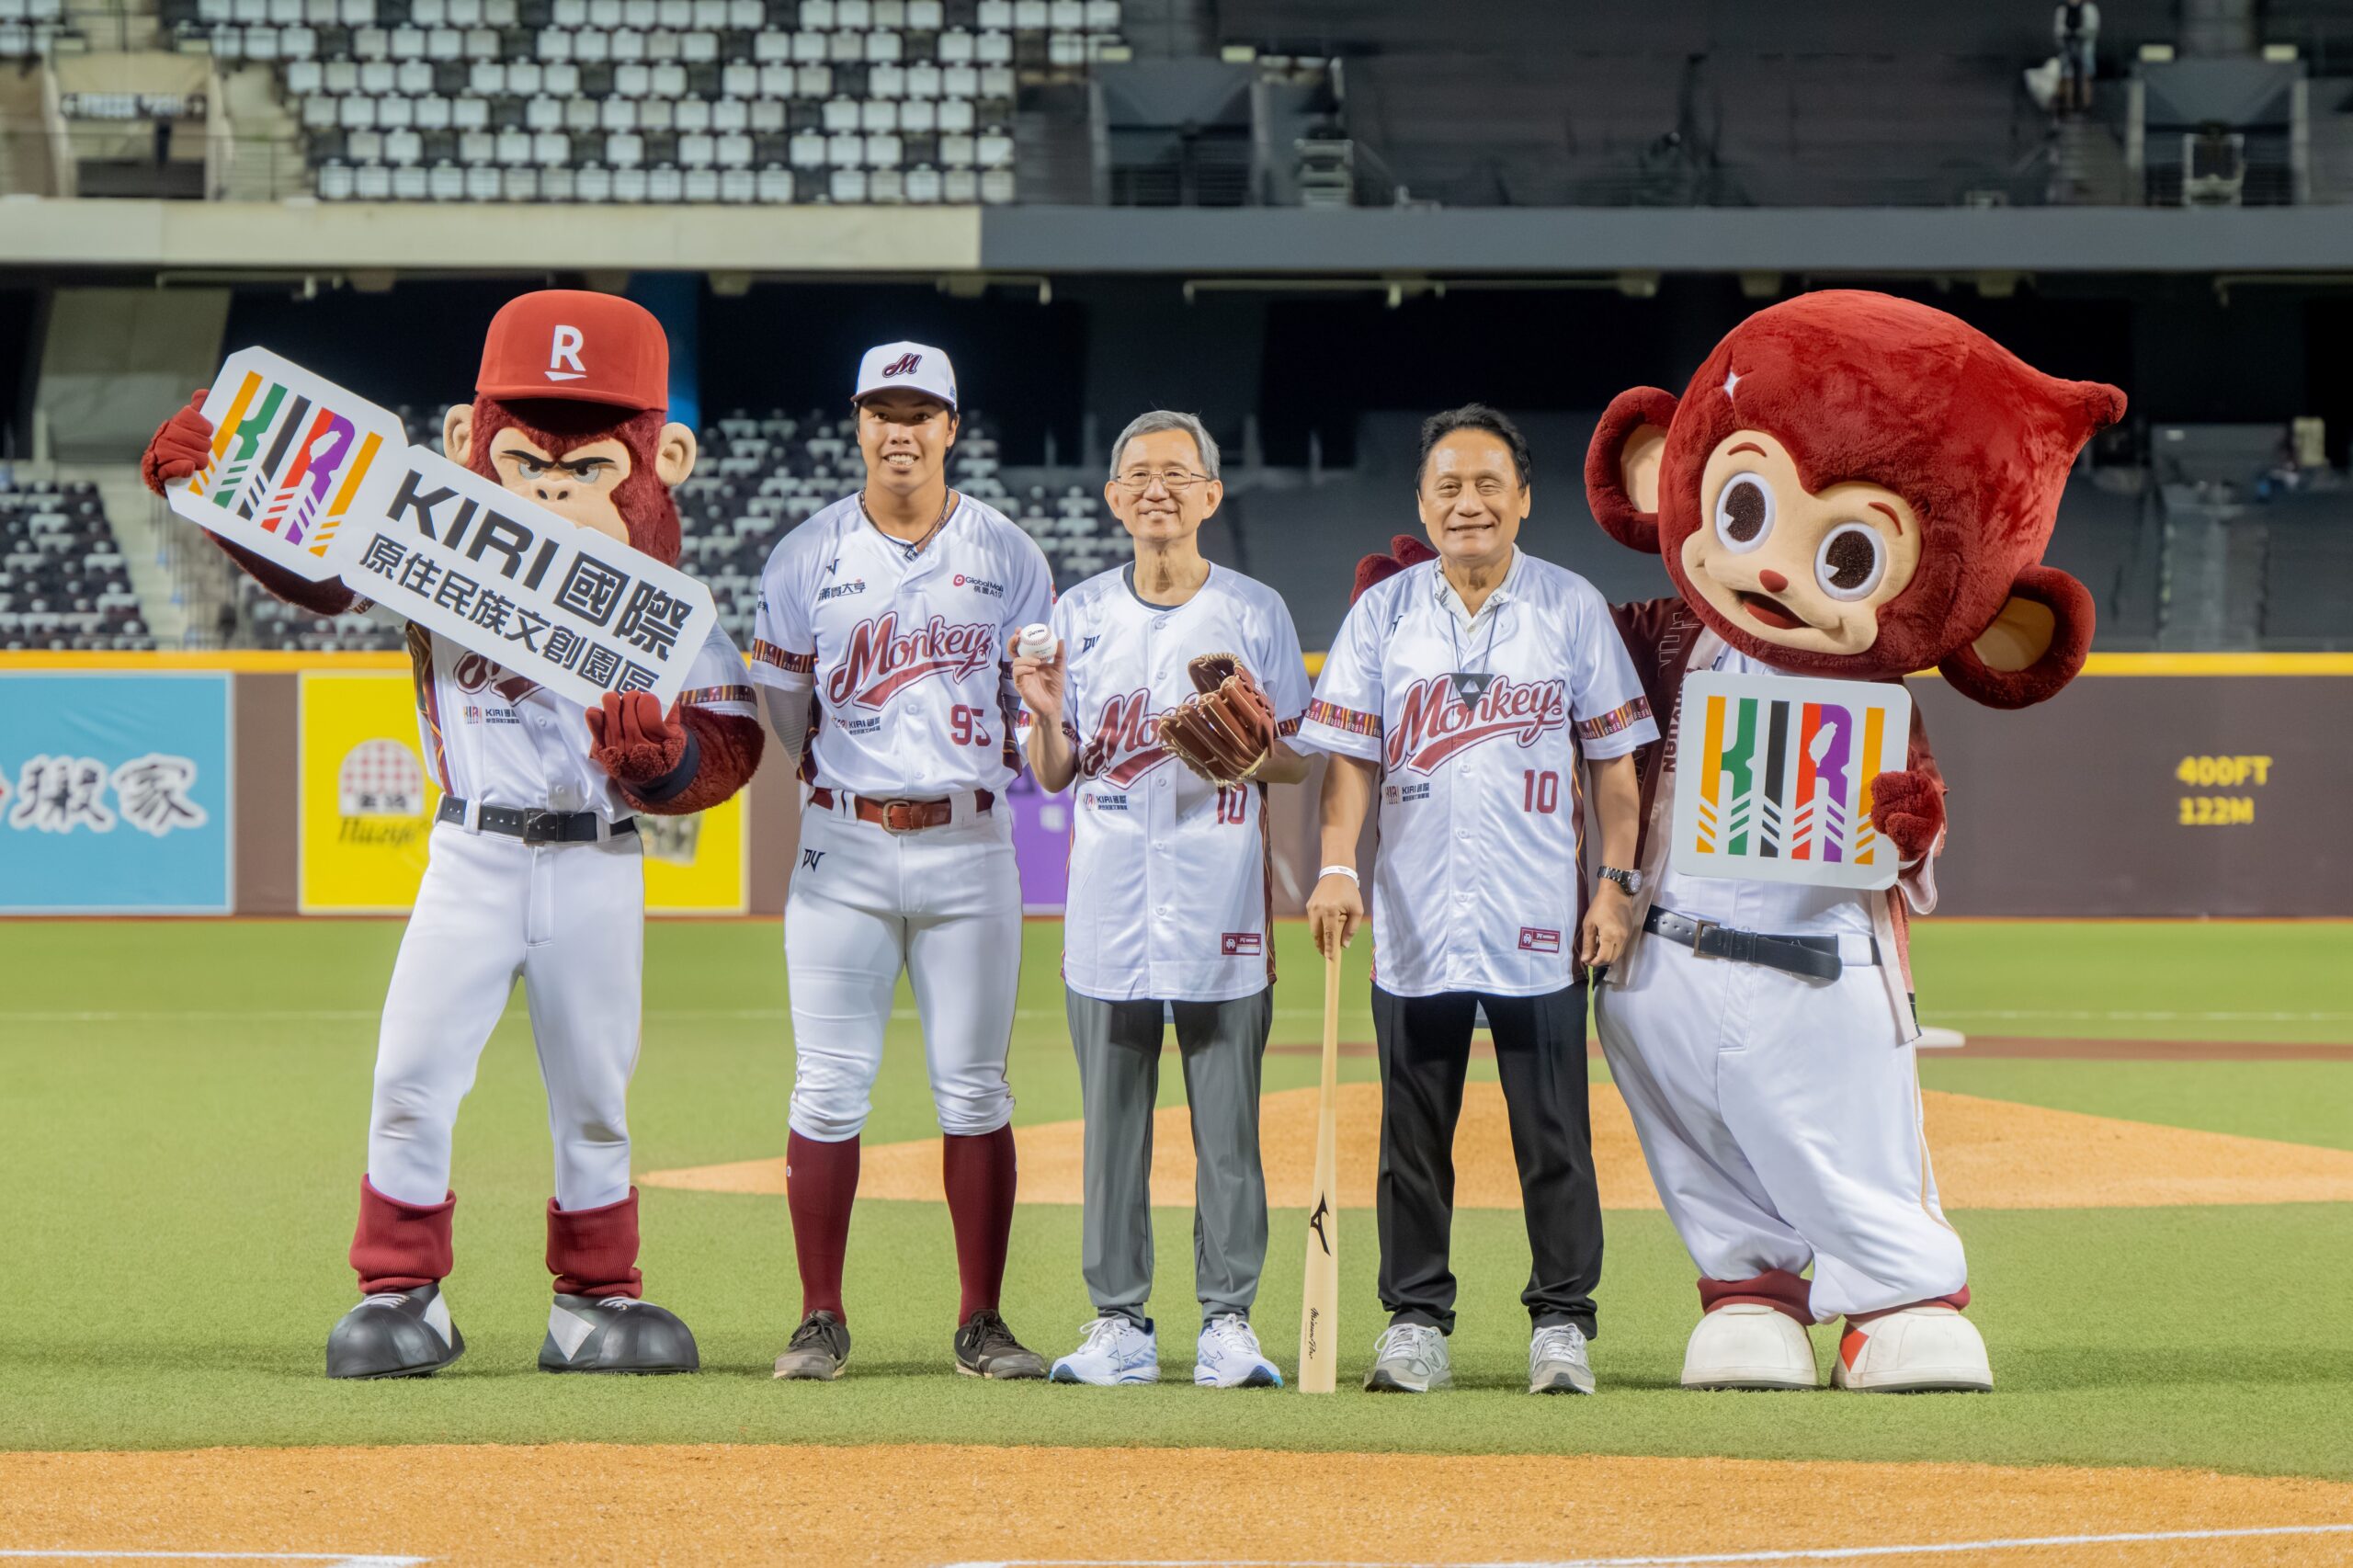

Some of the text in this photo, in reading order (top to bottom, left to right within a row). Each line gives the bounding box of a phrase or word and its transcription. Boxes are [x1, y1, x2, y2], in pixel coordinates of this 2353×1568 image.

[550, 324, 586, 371] R
[882, 353, 922, 378] M
[188, 369, 384, 558] KIRI
[359, 532, 660, 696] 原住民族文創園區
[827, 611, 995, 709] Monkeys
[1385, 674, 1565, 773] Monkeys
[1524, 769, 1559, 813] 10
[1697, 696, 1885, 866] KIRI
[2176, 756, 2273, 786] 400FT
[1217, 782, 1248, 824] 10
[2179, 796, 2255, 825] 122M
